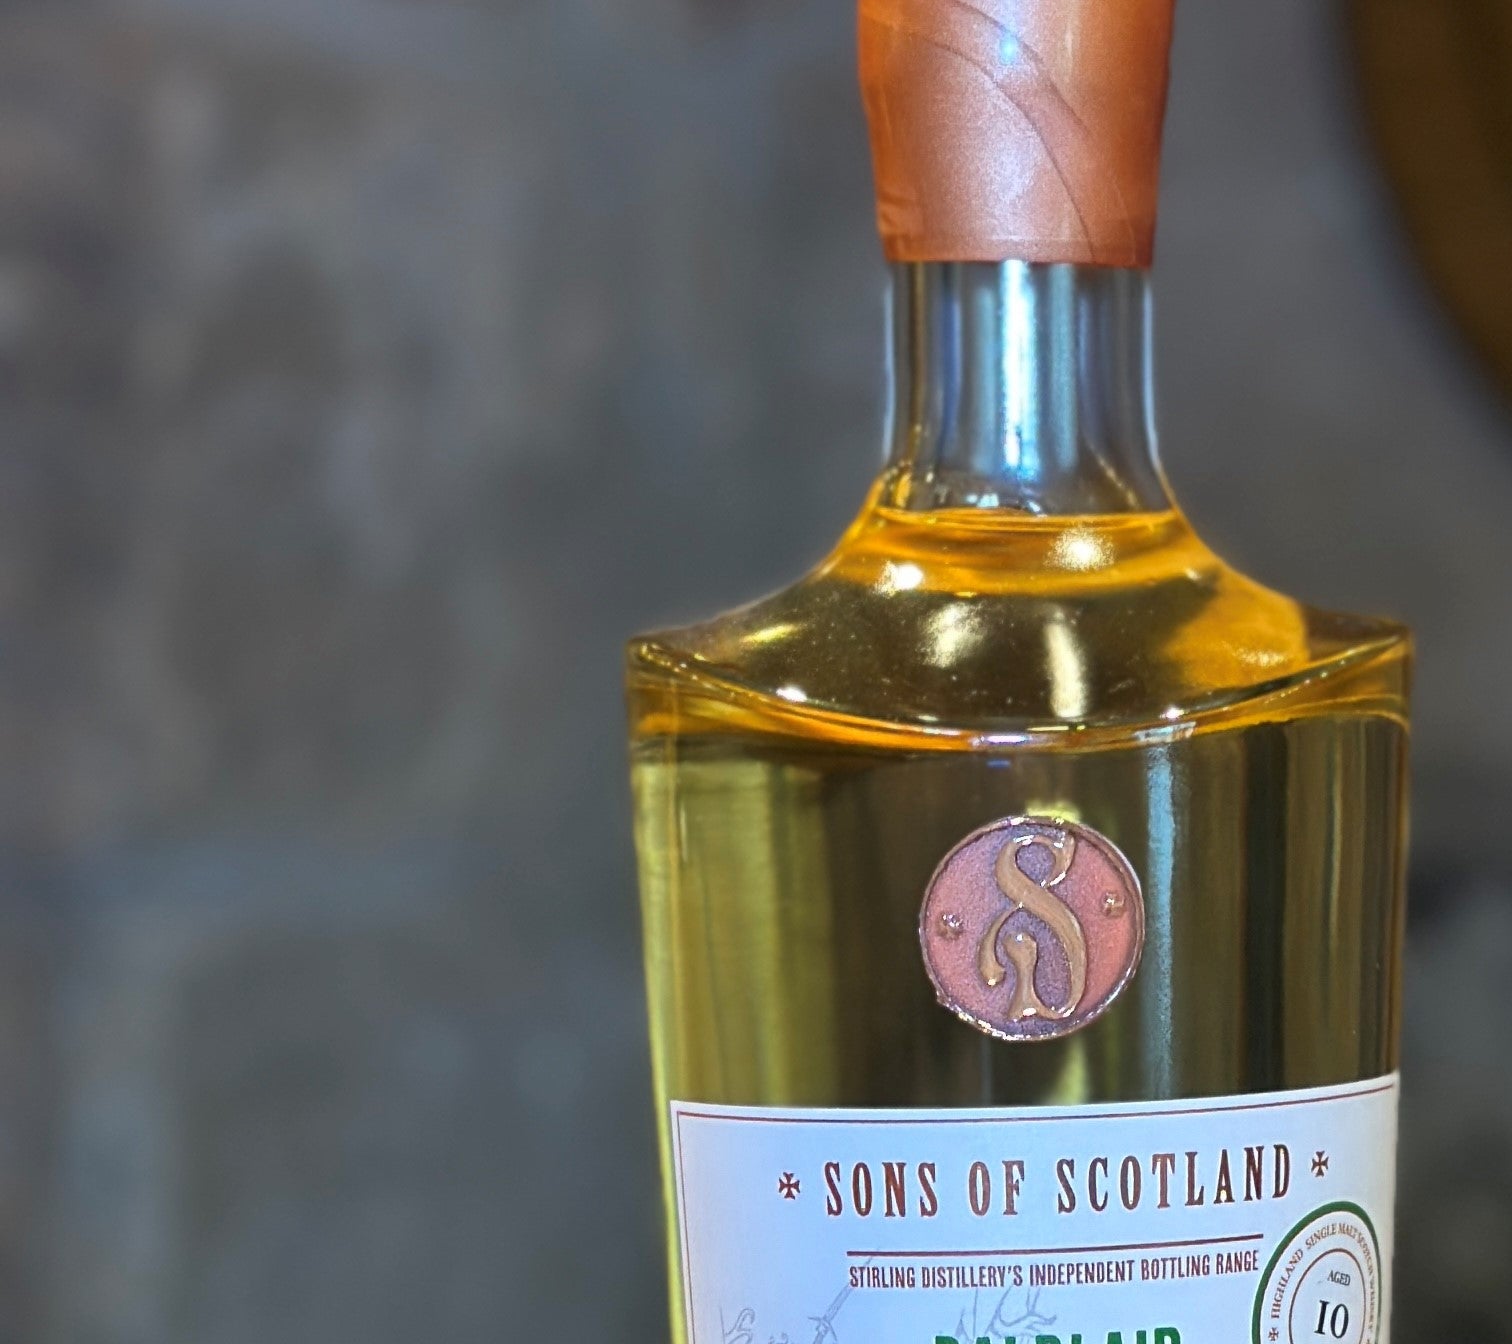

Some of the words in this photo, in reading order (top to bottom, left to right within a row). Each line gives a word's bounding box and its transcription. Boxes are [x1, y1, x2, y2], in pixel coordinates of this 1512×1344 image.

[824, 1161, 938, 1217] SONS
[968, 1160, 1025, 1216] OF
[1056, 1144, 1290, 1213] SCOTLAND
[849, 1265, 916, 1289] STIRLING
[921, 1264, 1023, 1289] DISTILLERY'S
[1029, 1259, 1135, 1287] INDEPENDENT
[1140, 1255, 1210, 1281] BOTTLING
[1215, 1250, 1259, 1275] RANGE
[1271, 1249, 1304, 1319] HIGHLAND
[1305, 1223, 1337, 1250] SINGLE
[1327, 1269, 1351, 1286] AGED
[1314, 1299, 1349, 1339] 10
